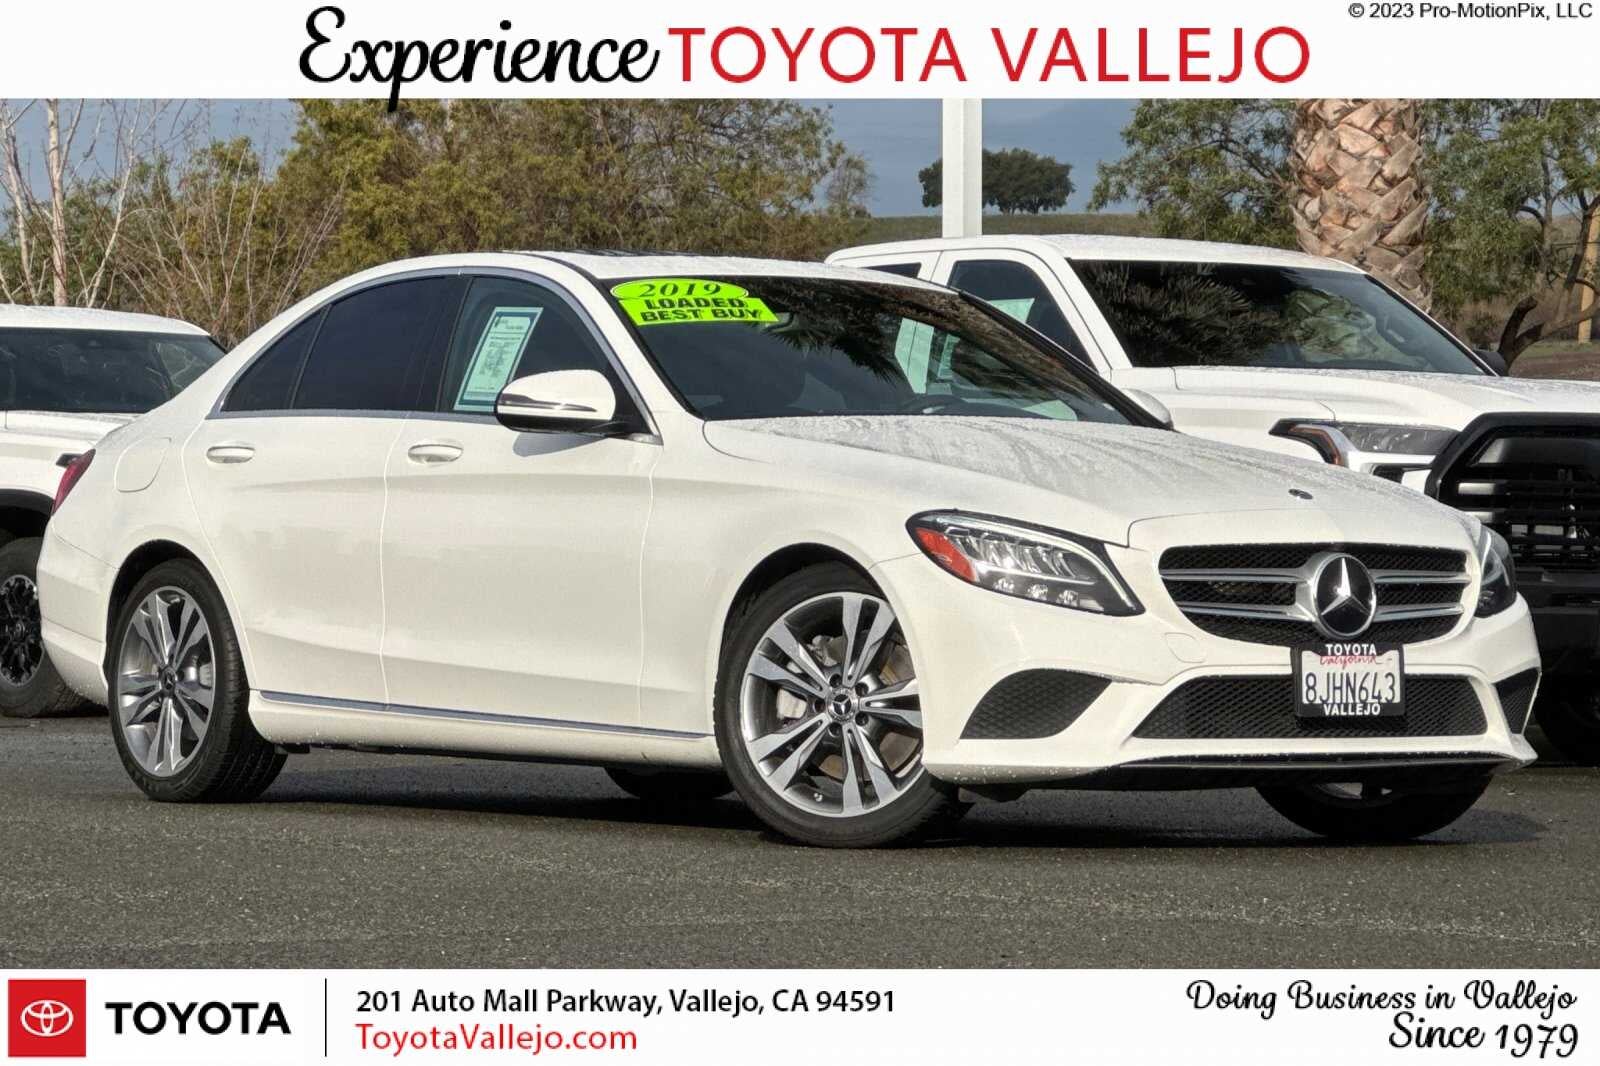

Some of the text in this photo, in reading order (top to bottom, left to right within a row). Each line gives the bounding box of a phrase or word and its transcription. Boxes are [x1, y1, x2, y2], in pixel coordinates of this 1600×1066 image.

[639, 283, 722, 298] 2019
[645, 298, 745, 309] LOADED
[641, 308, 760, 321] BEST BUY
[1324, 643, 1377, 656] TOYOTA
[1305, 672, 1396, 703] 8JHN643
[1323, 703, 1381, 716] VALLEJO
